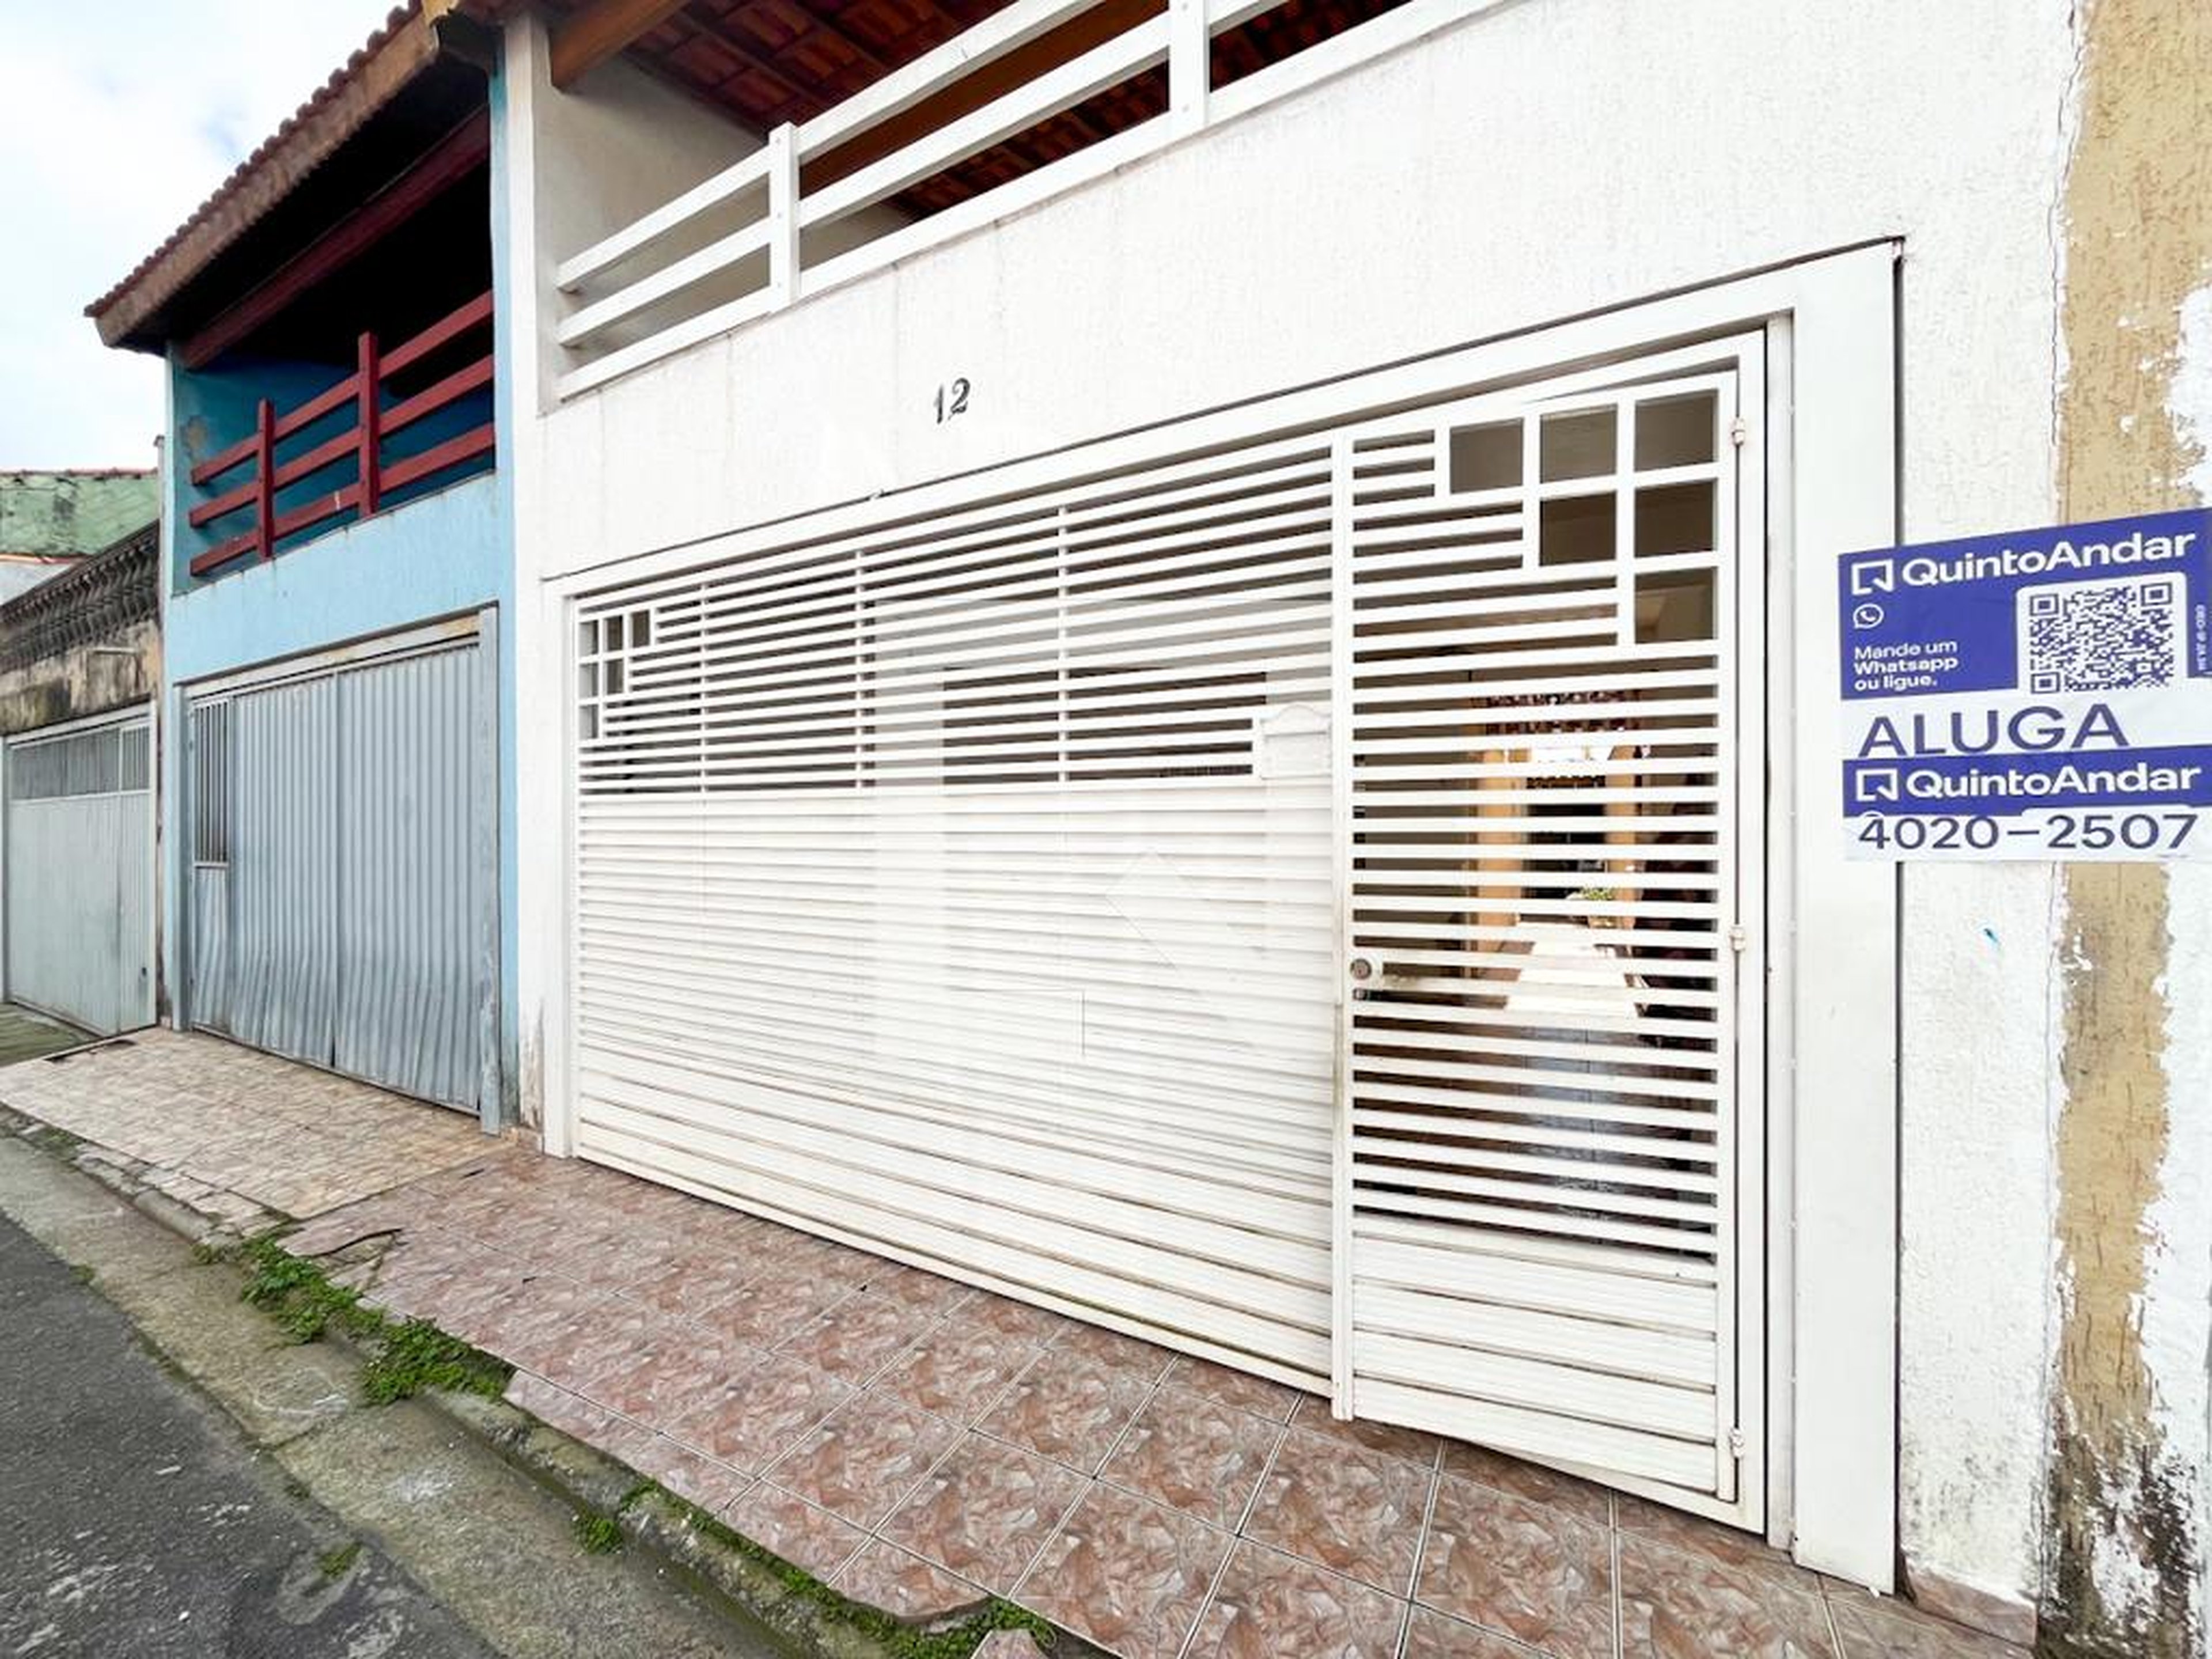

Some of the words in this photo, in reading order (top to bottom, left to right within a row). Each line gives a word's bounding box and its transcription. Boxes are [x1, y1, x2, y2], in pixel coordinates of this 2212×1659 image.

[933, 377, 971, 424] 12
[1902, 533, 2196, 585] QuintoAndar
[1926, 641, 1957, 654] um
[1854, 657, 1958, 675] Whatsapp
[1854, 679, 1879, 691] ou
[1883, 675, 1937, 691] ligue.
[1858, 703, 2130, 758] ALUGA
[1906, 763, 2202, 799] QuintoAndar
[1859, 813, 2198, 850] 4020-2507
